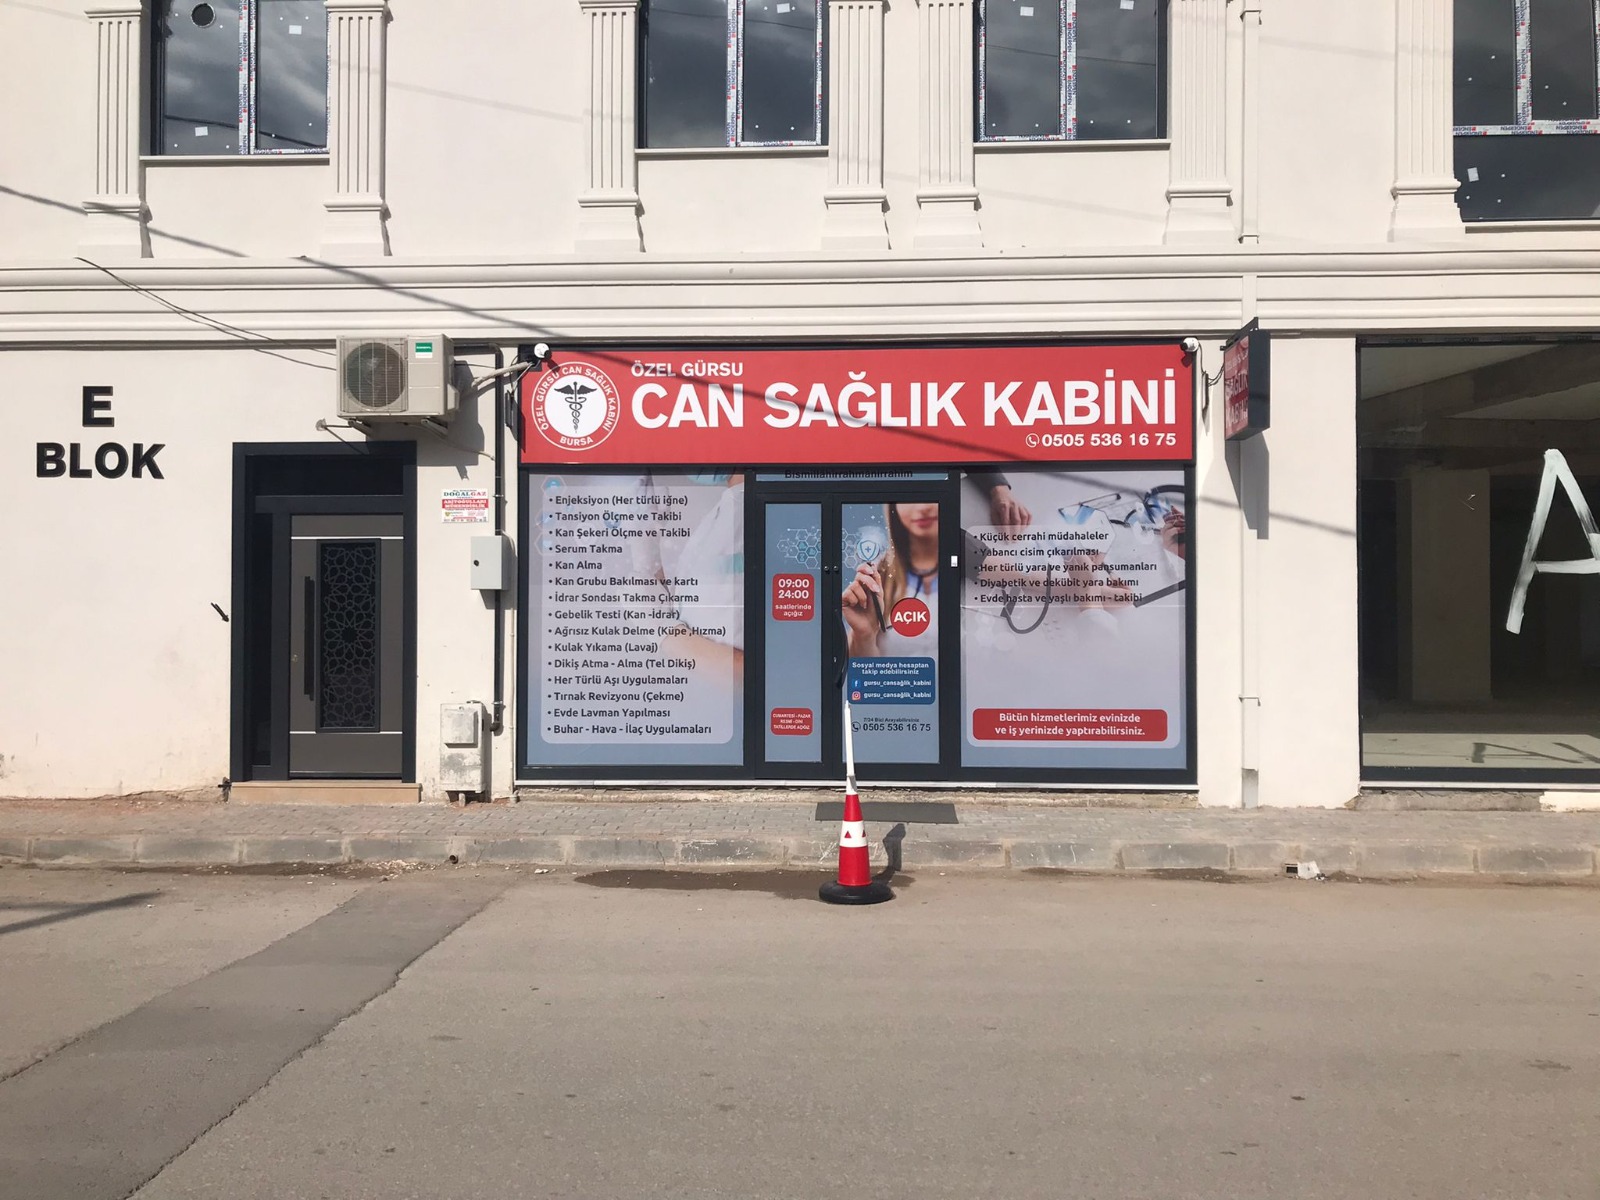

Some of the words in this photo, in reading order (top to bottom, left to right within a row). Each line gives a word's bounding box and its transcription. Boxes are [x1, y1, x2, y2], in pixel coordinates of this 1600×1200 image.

[562, 366, 582, 374] CAN
[631, 361, 676, 377] ÖZEL
[682, 360, 743, 376] GÜRSU
[536, 372, 560, 401] GÜRSU
[585, 368, 613, 395] SAĞLIK
[631, 383, 743, 428] CAN
[763, 371, 966, 428] SAĞLIK
[984, 368, 1175, 426] KABİNİ
[82, 386, 114, 427] E
[536, 406, 549, 430] ÖZEL
[560, 436, 593, 446] BURSA
[1042, 434, 1084, 447] 0505
[1090, 434, 1122, 446] 536
[1130, 434, 1149, 446] 16
[1155, 433, 1176, 446] 75
[36, 442, 166, 479] BLOK
[555, 496, 609, 506] Enjeksiyon
[612, 496, 633, 506] (Her
[636, 496, 660, 504] türlü
[663, 496, 688, 506] iğne)
[555, 512, 599, 522] Tansiyon
[603, 510, 634, 522] Ölçme
[651, 512, 681, 521] Takibi
[577, 529, 608, 538] Şekeri
[612, 527, 643, 538] Ölçme
[980, 533, 1009, 542] Küçük
[1012, 532, 1045, 541] cerrahi
[1048, 532, 1109, 541] müdahaleler
[980, 548, 1017, 557] Yabancı
[1020, 548, 1044, 556] cisim
[1047, 548, 1099, 558] çıkarılması
[577, 561, 602, 569] Alma
[980, 564, 998, 572] Her
[1000, 563, 1023, 572] türlü
[1026, 565, 1047, 574] yara
[1063, 563, 1089, 573] yanık
[1092, 562, 1157, 573] pansumanları
[577, 577, 607, 585] Grubu
[610, 577, 657, 585] Bakılması
[674, 577, 698, 585] kartı
[779, 579, 809, 588] 09:00
[980, 578, 1027, 589] Diyabetik
[1043, 578, 1080, 587] dekübit
[1083, 580, 1104, 589] yara
[555, 592, 579, 602] İdrar
[658, 594, 699, 604] Çıkarma
[778, 590, 809, 599] 24:00
[981, 594, 1004, 602] Evde
[1006, 594, 1032, 602] hasta
[1049, 594, 1072, 604] yaşlı
[1074, 594, 1106, 602] bakımı
[1114, 593, 1142, 602] takibi
[555, 610, 593, 619] Gebelik
[596, 610, 620, 619] Testi
[624, 610, 646, 620] (Kan
[894, 611, 926, 624] AÇIK
[554, 627, 589, 637] Ağrısız
[592, 627, 620, 635] Kulak
[622, 627, 655, 635] Delme
[658, 627, 686, 637] (Küpe
[625, 644, 658, 653] (Lavaj)
[554, 660, 579, 670] Dikiş
[618, 660, 643, 668] Alma
[645, 659, 665, 669] (Tel
[668, 659, 695, 670] Dikiş)
[575, 676, 601, 684] Türlü
[604, 676, 619, 686] Aşı
[622, 676, 688, 686] Uygulamaları
[589, 692, 639, 702] Revizyonu
[643, 692, 684, 702] (Çekme)
[622, 709, 670, 718] Yapılması
[999, 713, 1028, 722] Bütün
[1031, 713, 1097, 722] hizmetlerimiz
[1100, 714, 1140, 723] evinizde
[626, 723, 643, 735] İlaç
[645, 726, 711, 735] Uygulamaları
[1009, 726, 1017, 736] iş
[1019, 726, 1063, 736] yerinizde
[1066, 726, 1145, 736] yaptırabilirsiniz.
